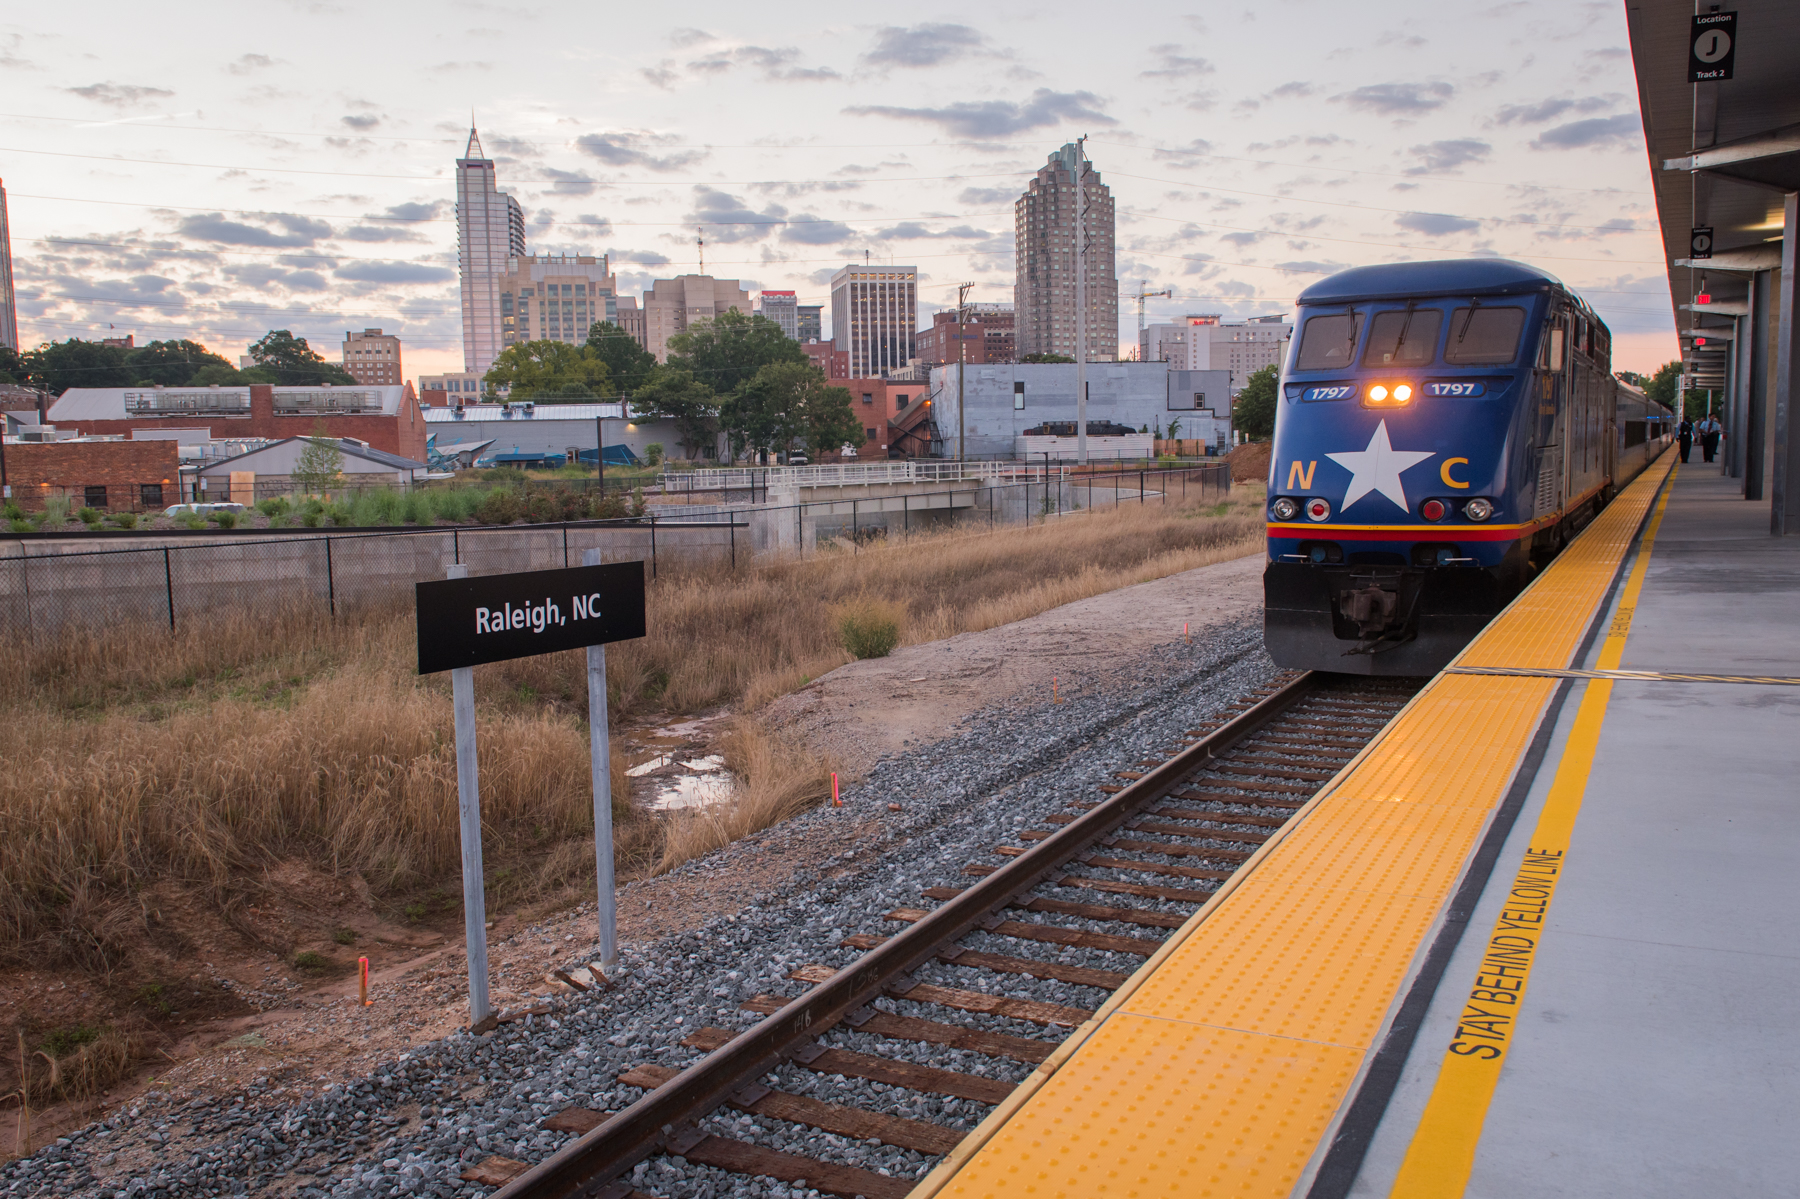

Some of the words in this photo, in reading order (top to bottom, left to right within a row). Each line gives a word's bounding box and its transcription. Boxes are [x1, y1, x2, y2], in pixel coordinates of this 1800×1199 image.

[1696, 15, 1732, 24] Location
[1705, 36, 1718, 56] J
[1696, 70, 1718, 79] Track
[1719, 69, 1725, 77] 2
[1311, 386, 1350, 400] 1797
[1431, 383, 1475, 395] 1797
[1286, 460, 1317, 490] N
[1440, 457, 1470, 489] C
[475, 597, 566, 634] Raleigh,
[572, 593, 601, 621] NC
[1519, 848, 1563, 875] LINE
[1497, 875, 1553, 930] YELLOW
[1470, 935, 1535, 1005] BEHIND
[1449, 1004, 1511, 1060] STAY
